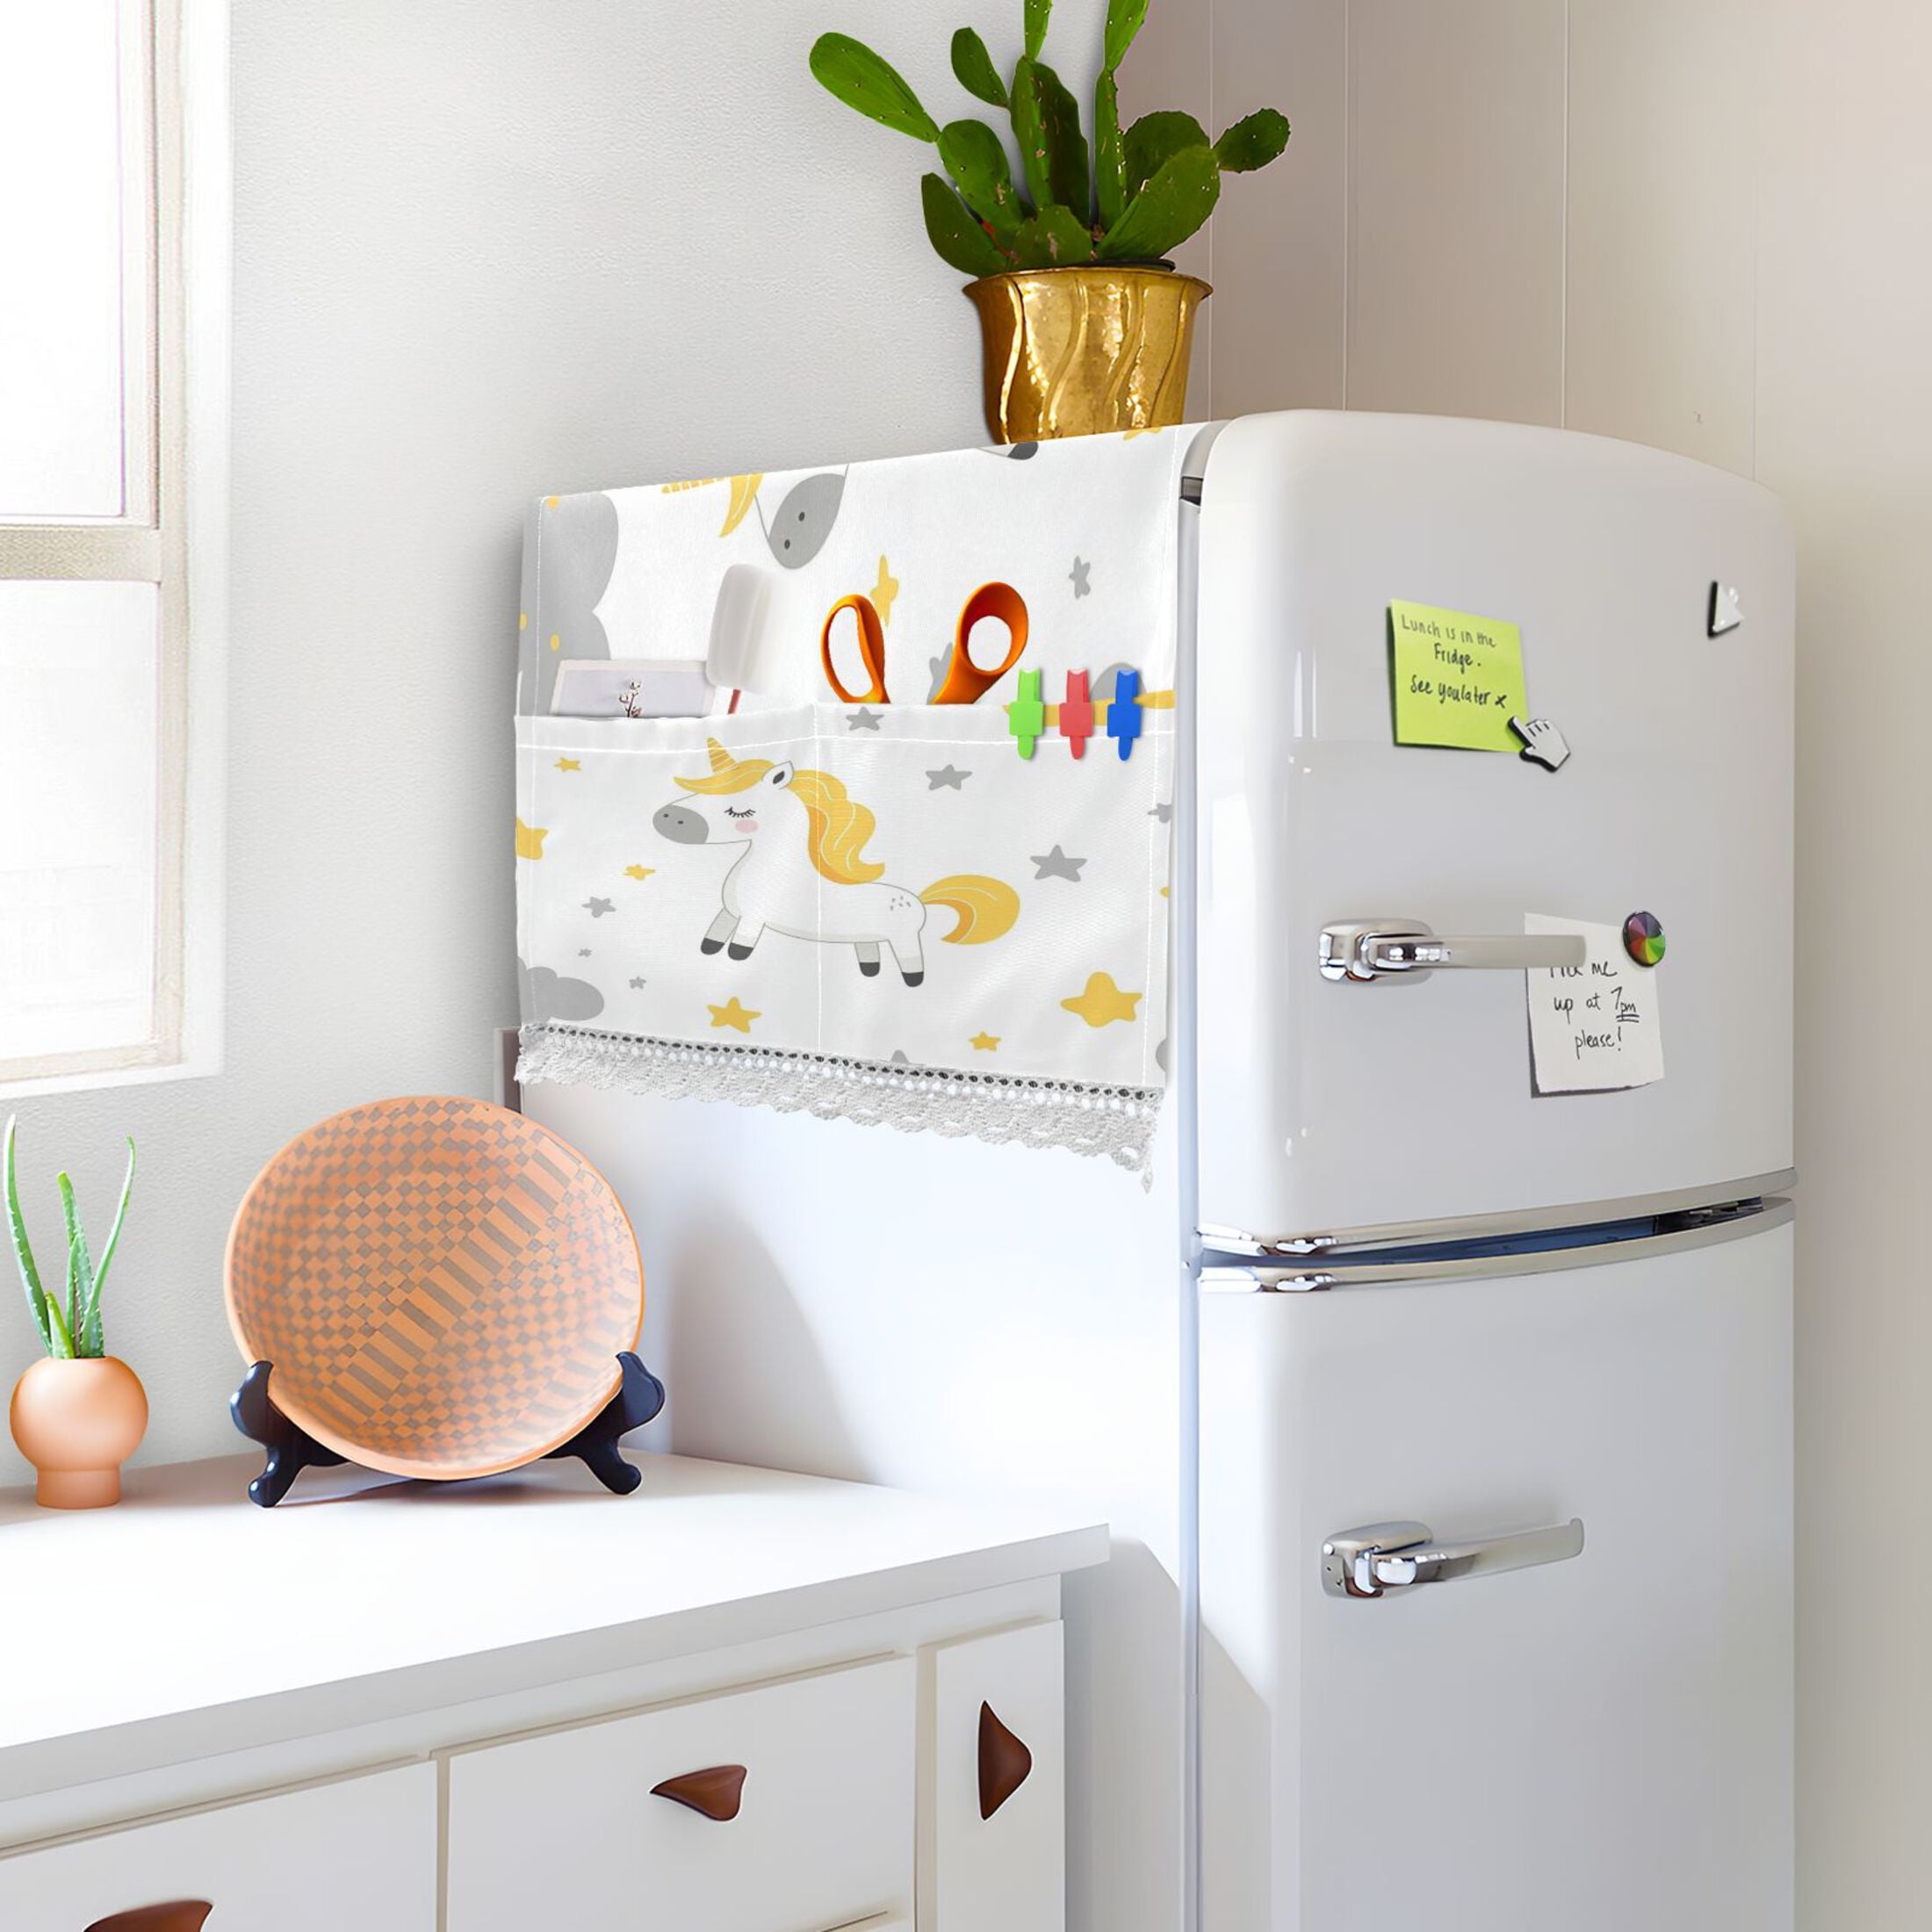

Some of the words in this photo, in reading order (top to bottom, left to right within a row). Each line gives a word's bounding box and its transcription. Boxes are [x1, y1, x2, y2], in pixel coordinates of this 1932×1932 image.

[1402, 614, 1441, 638] Lunch
[1461, 630, 1474, 644] in
[1477, 632, 1496, 648] the
[1410, 674, 1433, 694] See
[1591, 961, 1618, 977] me
[1554, 997, 1574, 1025] up
[1586, 991, 1601, 1011] at
[1575, 1026, 1622, 1060] please!
